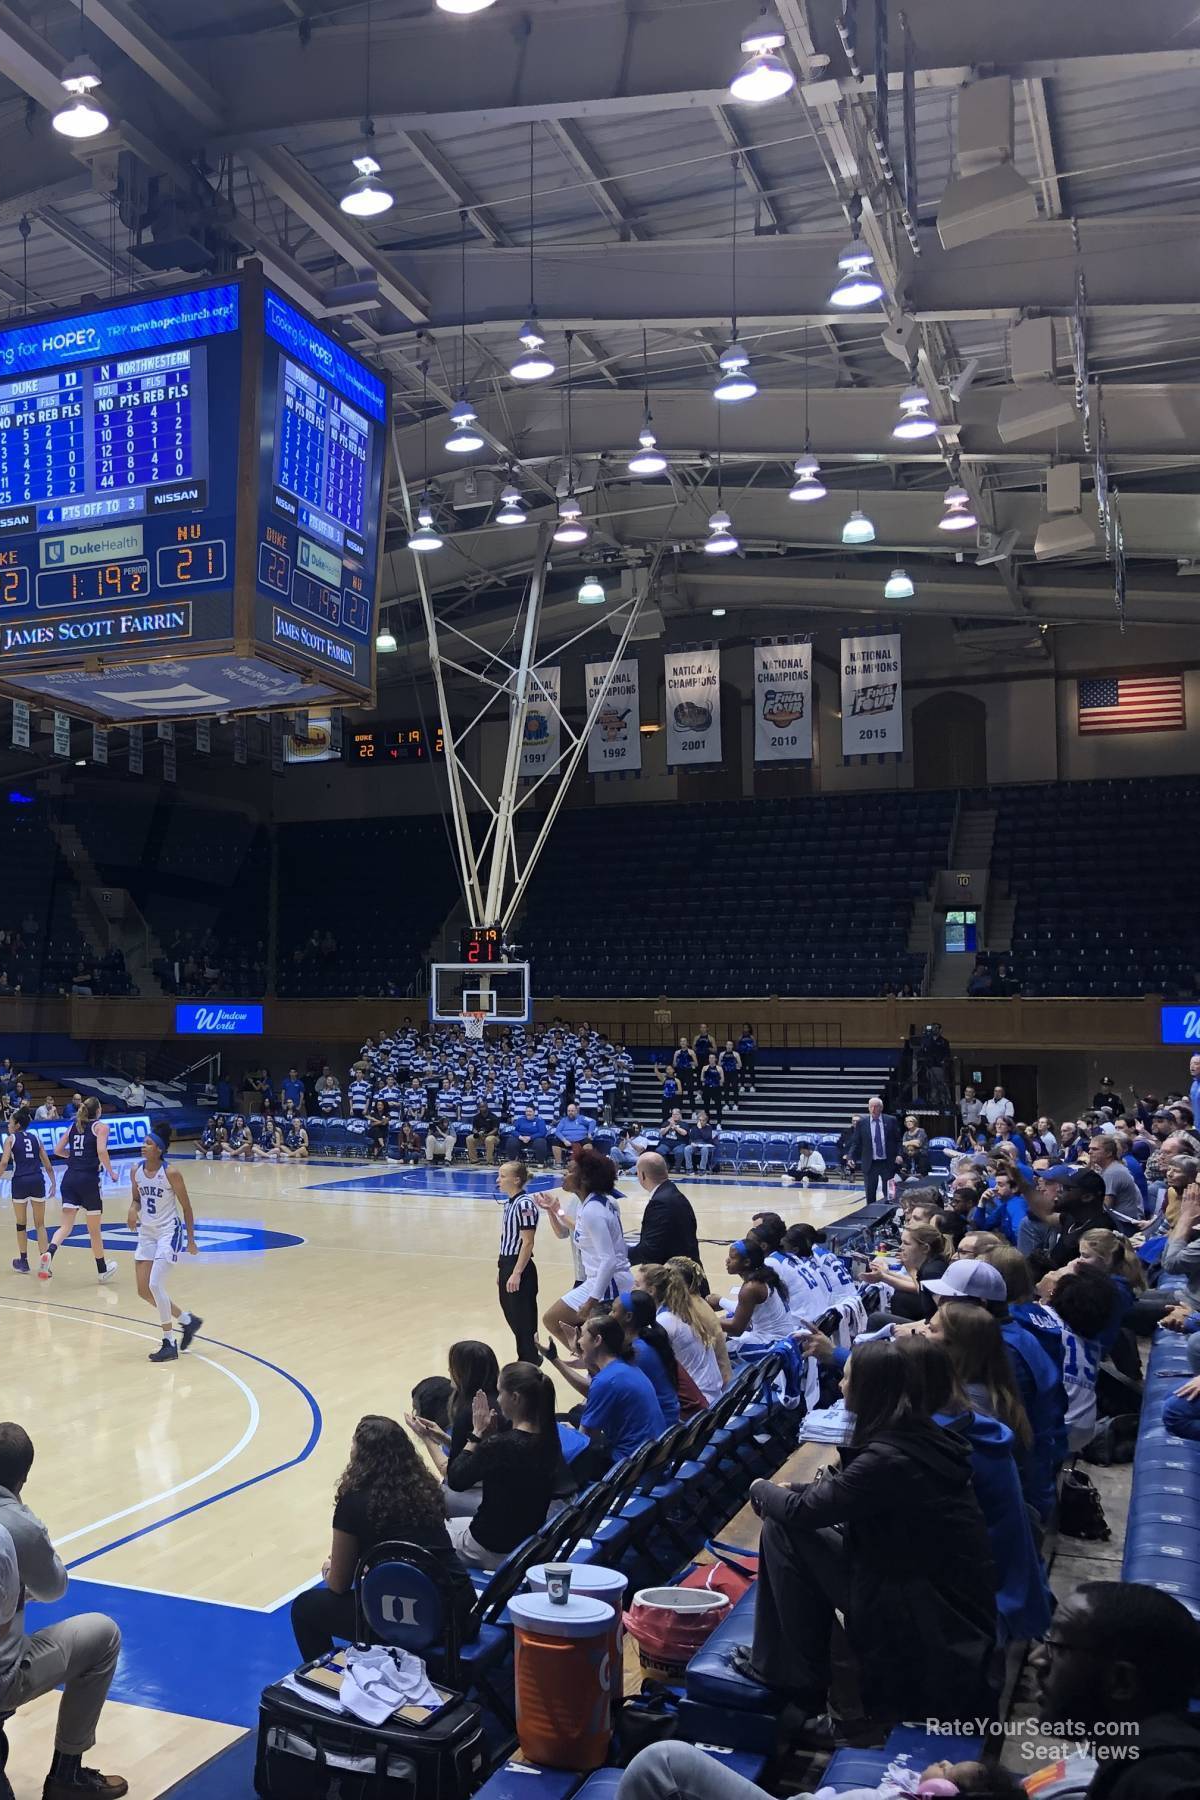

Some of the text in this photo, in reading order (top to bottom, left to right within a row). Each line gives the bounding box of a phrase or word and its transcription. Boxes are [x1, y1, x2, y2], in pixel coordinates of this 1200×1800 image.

[17, 343, 38, 357] for
[42, 329, 96, 352] HOPE?
[309, 339, 333, 366] HOPE?
[117, 350, 191, 376] NORTHWESTERN
[12, 380, 39, 395] DUKE
[126, 381, 133, 392] 3
[22, 401, 28, 411] 3
[67, 392, 74, 402] 4
[99, 384, 189, 412] NO PTS REB FLS
[16, 412, 35, 426] PTS
[39, 408, 58, 422] REB
[62, 404, 81, 418] FLS
[103, 405, 157, 426] 3 2 4
[1, 424, 52, 444] 2 5 2
[101, 417, 182, 442] 10 8 3 2
[1, 439, 52, 459] 3 3 4
[101, 432, 182, 458] 12 0 2
[1, 451, 75, 474] 5 4 3 0
[102, 448, 183, 473] 21 8 4 0
[1, 466, 76, 489] 11 2 2 0
[100, 464, 183, 488] 44 0 2 0
[0, 481, 76, 504] 25 6 2 2
[154, 489, 199, 505] NISSAN
[47, 497, 135, 521] 4 PTS OFF TO 3
[275, 495, 295, 515] NISSAN
[177, 524, 201, 541] NU
[70, 535, 138, 556] DukeHealth
[176, 547, 213, 581] 21
[72, 564, 121, 600] 1:19
[131, 574, 141, 591] 2
[4, 611, 185, 650] JAMES SCOTT FARRIN
[275, 615, 353, 665] JAMES SCOTT FARRIN
[757, 670, 809, 683] CHAMPIONS
[589, 685, 636, 698] CHMPIONS
[398, 730, 420, 744] 1:19
[770, 735, 797, 747] 2010
[859, 728, 887, 740] 2015
[359, 745, 375, 757] 22
[603, 748, 626, 758] 1992
[681, 740, 706, 751] 2001
[524, 753, 546, 763] 1991
[475, 930, 497, 941] 1:19
[467, 942, 493, 962] 21
[23, 1138, 33, 1152] 3
[73, 1134, 86, 1150] 21
[139, 1186, 164, 1198] DUKE
[146, 1197, 157, 1215] 5
[797, 1267, 818, 1290] 13
[548, 1579, 563, 1598] G
[504, 1761, 542, 1776] A
